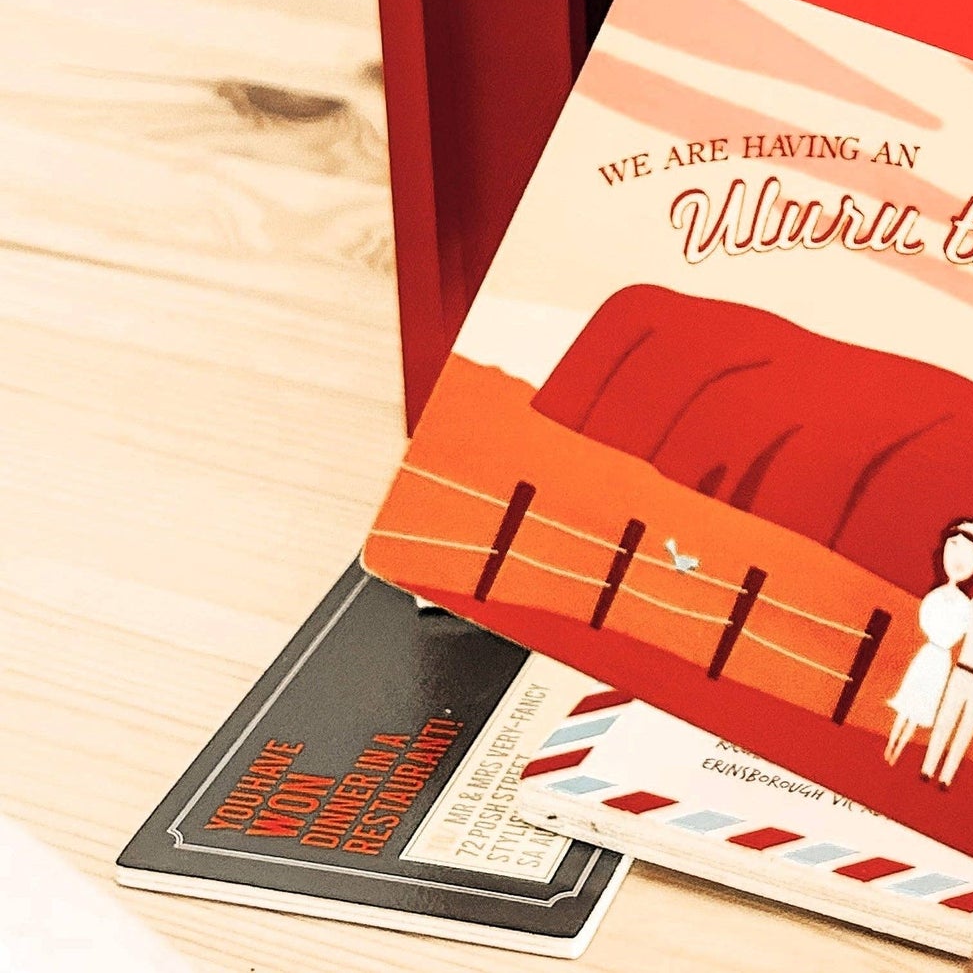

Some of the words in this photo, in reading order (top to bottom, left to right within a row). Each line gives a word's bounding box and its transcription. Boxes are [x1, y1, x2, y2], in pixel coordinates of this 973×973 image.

[598, 152, 653, 187] WE
[664, 137, 729, 170] ARE
[742, 134, 861, 162] HAVING
[870, 141, 921, 169] AN
[670, 175, 925, 265] Uluru
[372, 733, 411, 749] A
[486, 683, 550, 758] VERY-FANCY
[354, 748, 400, 772] IN
[466, 761, 504, 790] MRS
[491, 754, 530, 803] STREET
[702, 757, 826, 800] ERINSBOROUGH
[203, 789, 265, 830] YOU
[236, 738, 305, 791] HAVE
[245, 772, 337, 838] WON
[342, 717, 464, 855] RESTAURANT!
[458, 792, 483, 802] &
[300, 772, 384, 849] DINNER
[443, 803, 476, 825] MR
[467, 803, 510, 840] POSH
[455, 840, 486, 857] 72
[516, 850, 545, 868] SA
